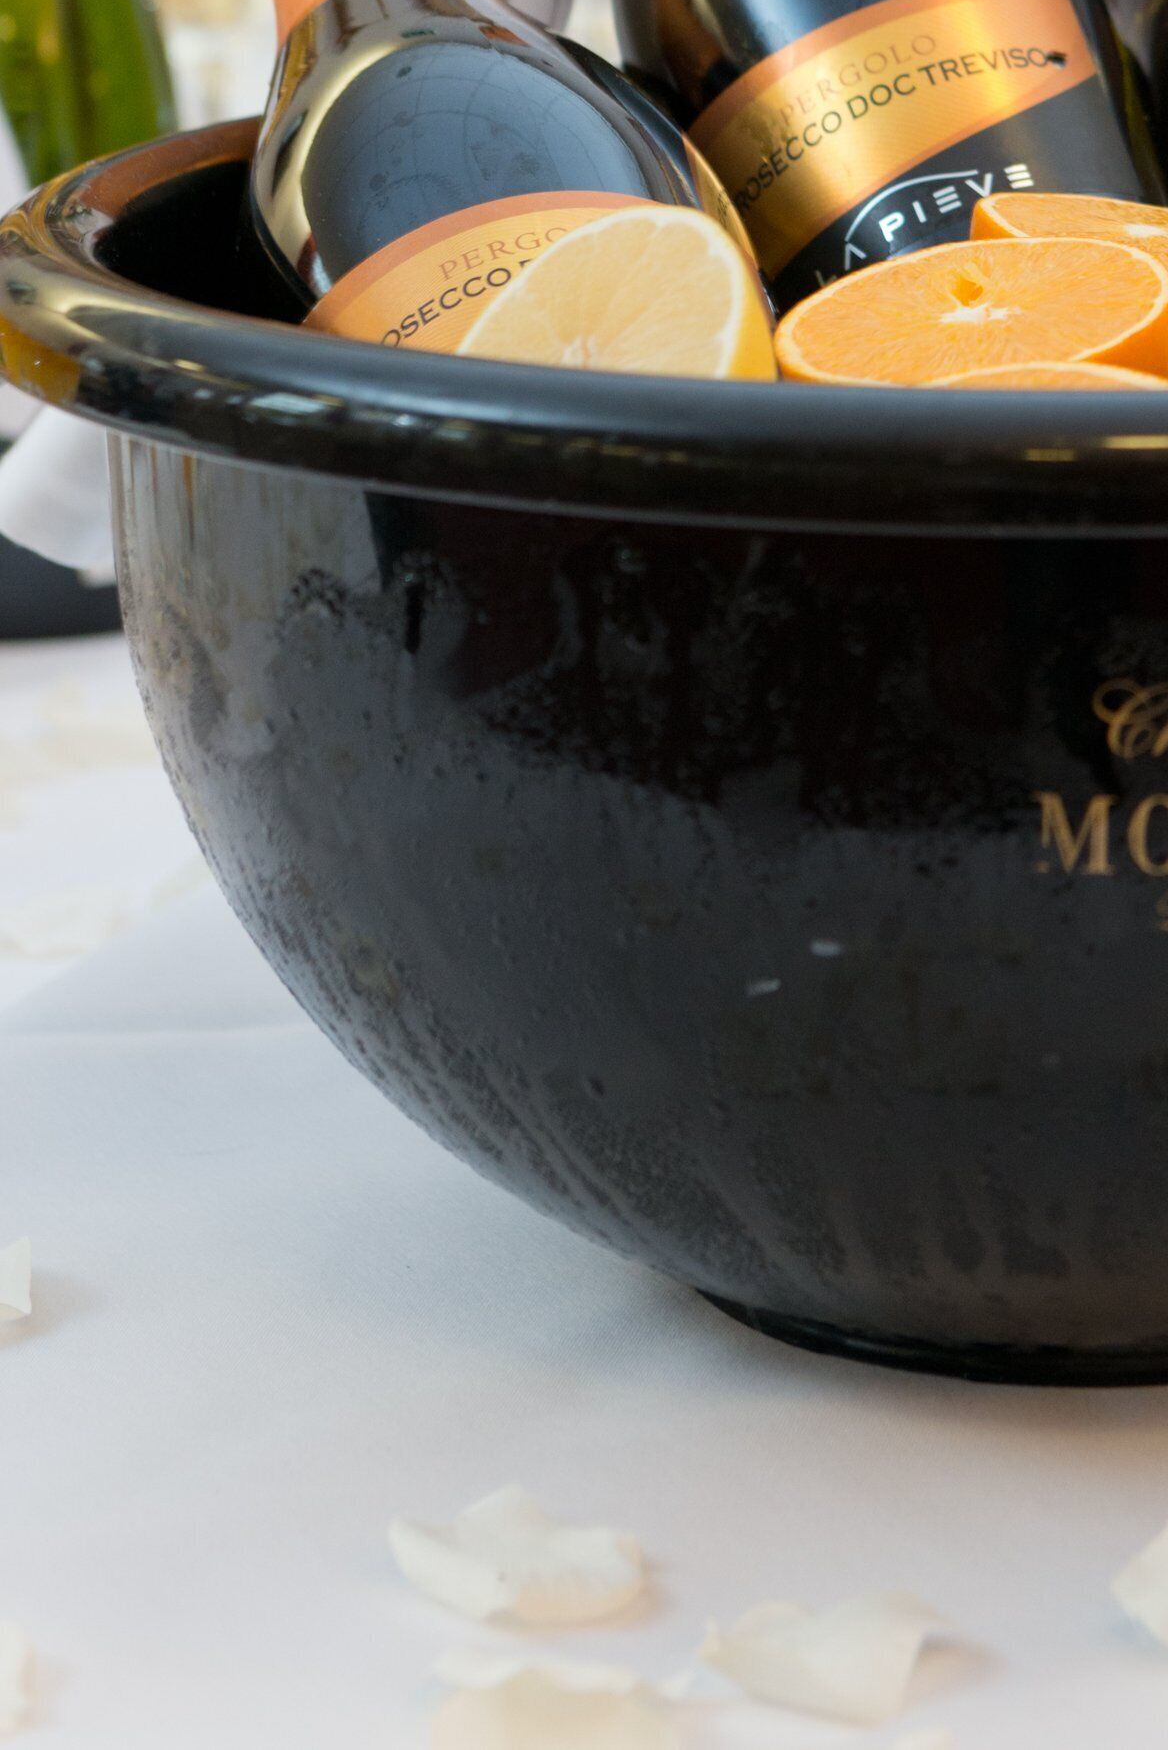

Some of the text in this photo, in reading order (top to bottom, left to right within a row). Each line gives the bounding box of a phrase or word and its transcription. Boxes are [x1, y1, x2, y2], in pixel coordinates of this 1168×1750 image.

[779, 35, 936, 126] PERGOLO
[847, 74, 916, 119] DOC
[918, 48, 1049, 86] TREVISO
